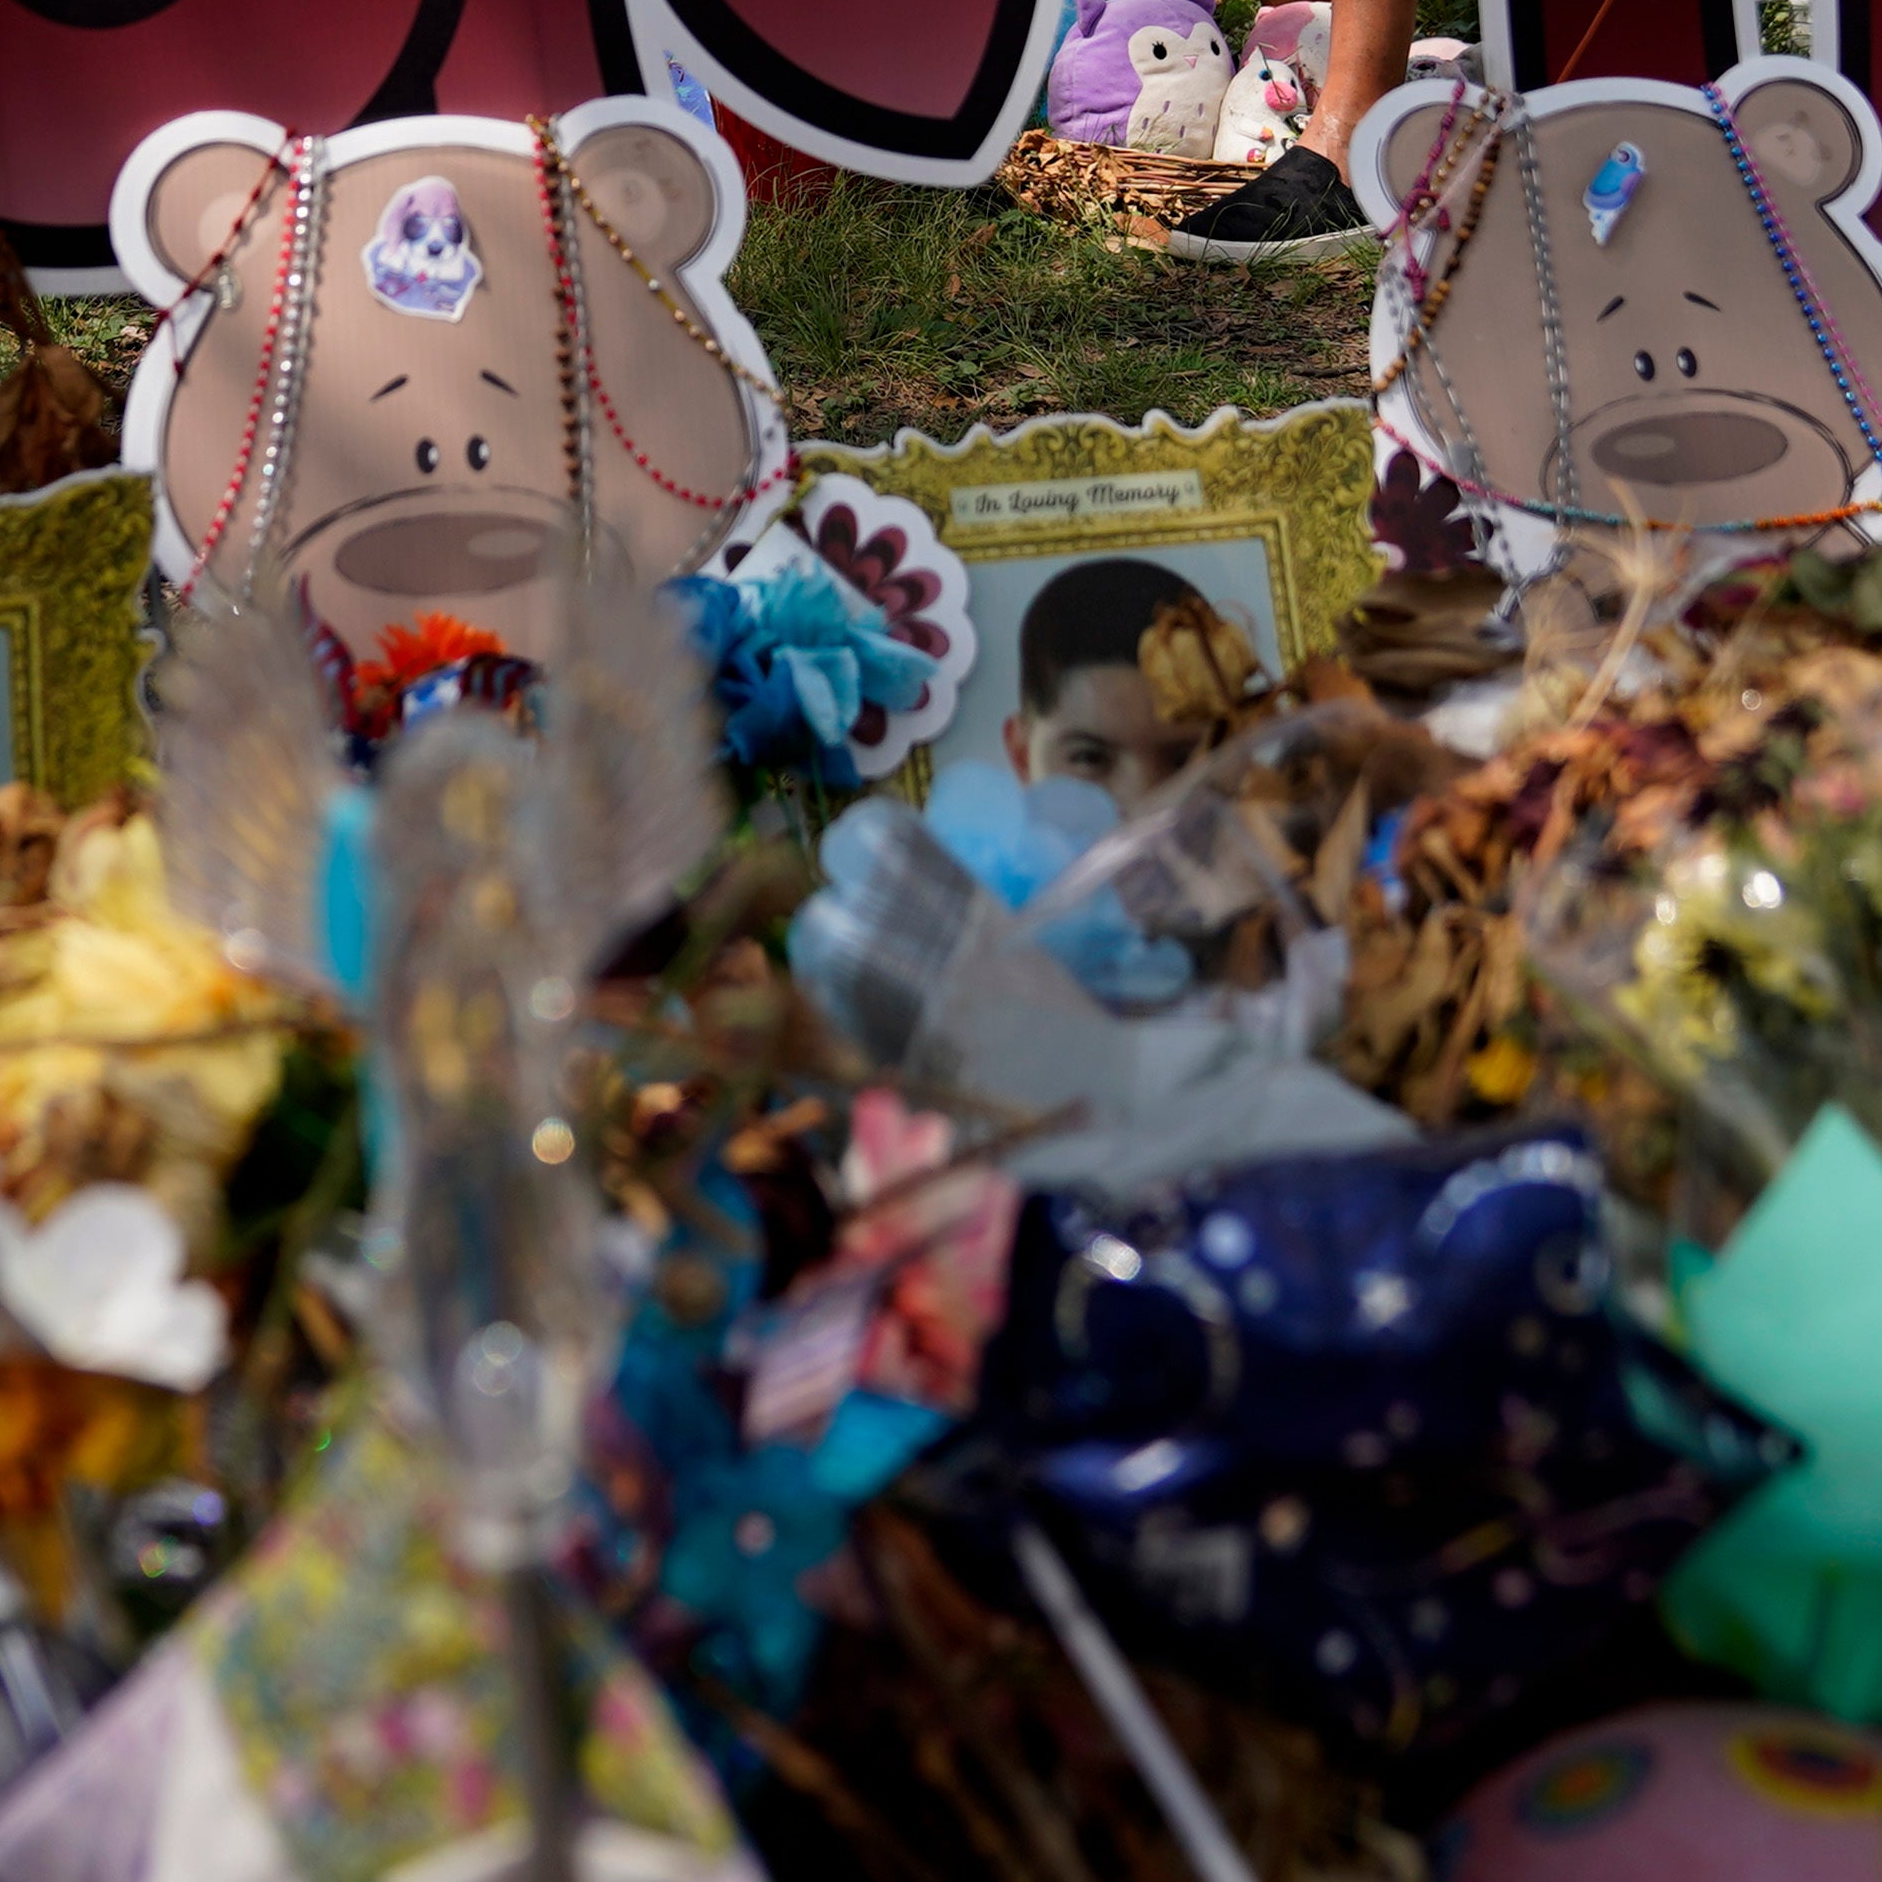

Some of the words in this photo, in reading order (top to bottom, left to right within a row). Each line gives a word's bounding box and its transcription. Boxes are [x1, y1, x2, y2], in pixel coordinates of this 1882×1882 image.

[974, 492, 1002, 514] In
[1008, 489, 1080, 514] Loving
[1086, 482, 1181, 507] Memory
